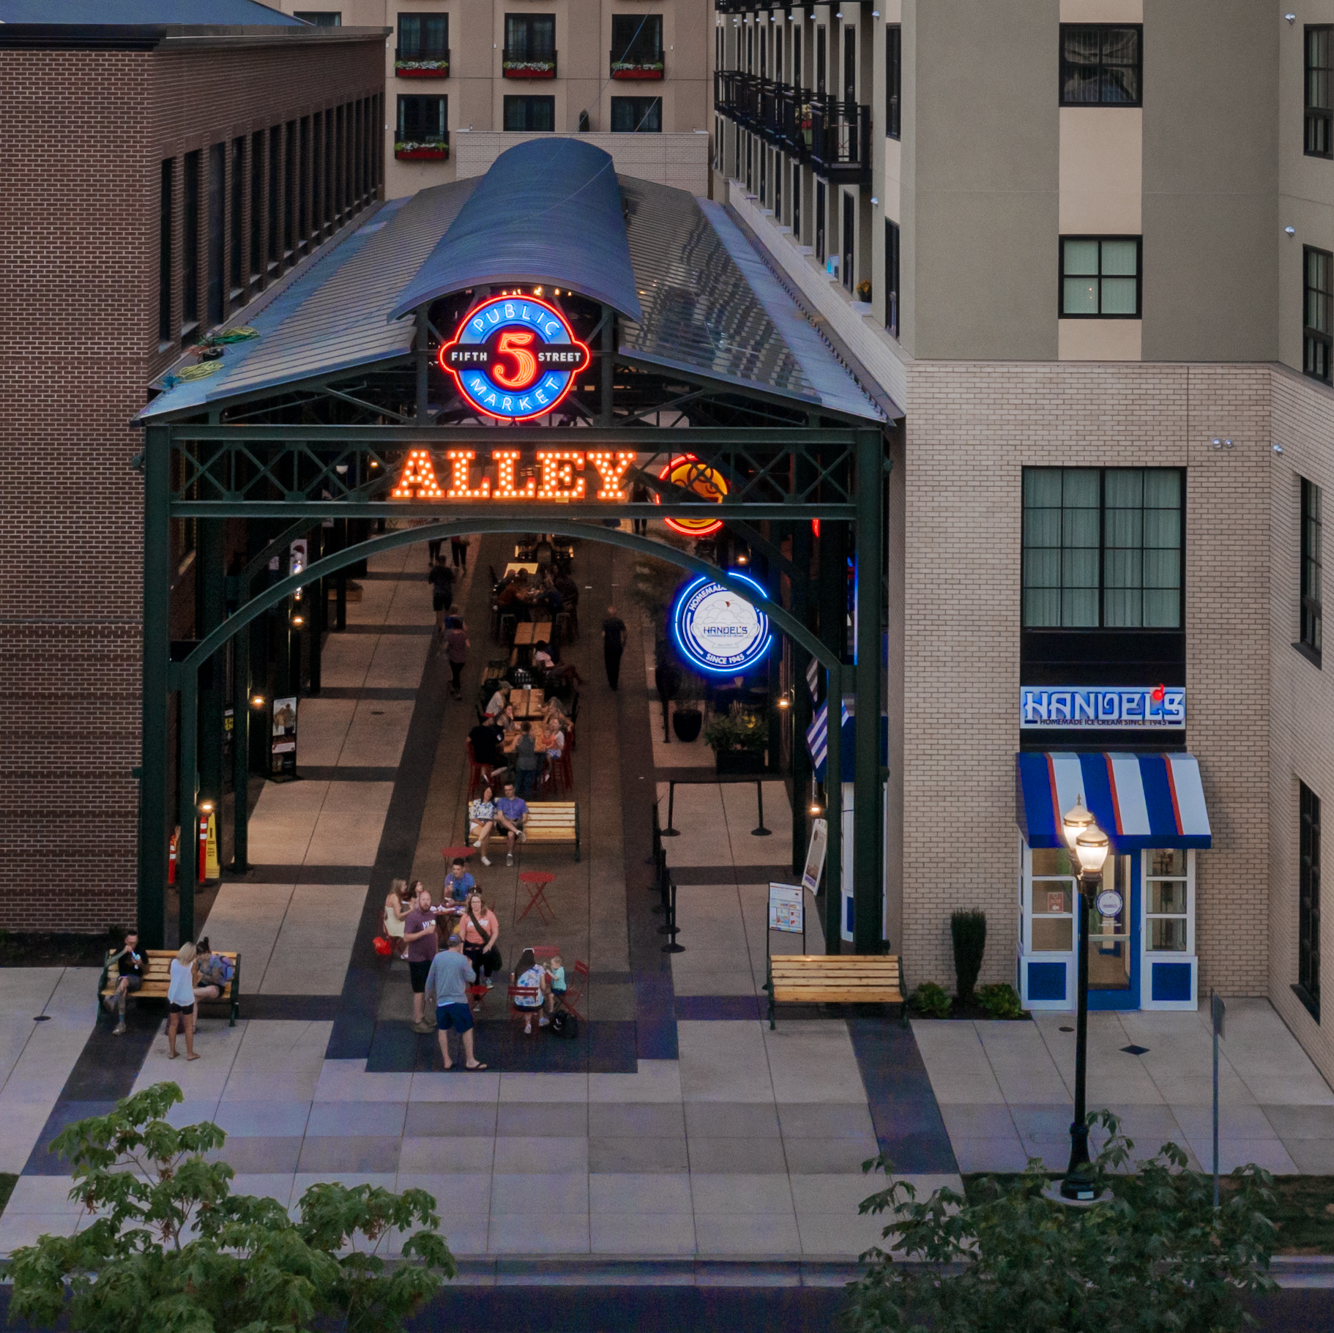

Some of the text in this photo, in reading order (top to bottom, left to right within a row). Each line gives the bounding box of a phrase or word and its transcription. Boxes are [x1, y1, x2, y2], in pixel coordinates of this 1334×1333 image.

[473, 303, 560, 336] PUBLIC
[451, 352, 487, 361] FIFTH
[493, 332, 536, 388] 5
[538, 352, 581, 361] STREET
[470, 377, 560, 411] MARKET
[391, 450, 636, 500] ALLEY
[705, 653, 745, 664] SINCE 1945
